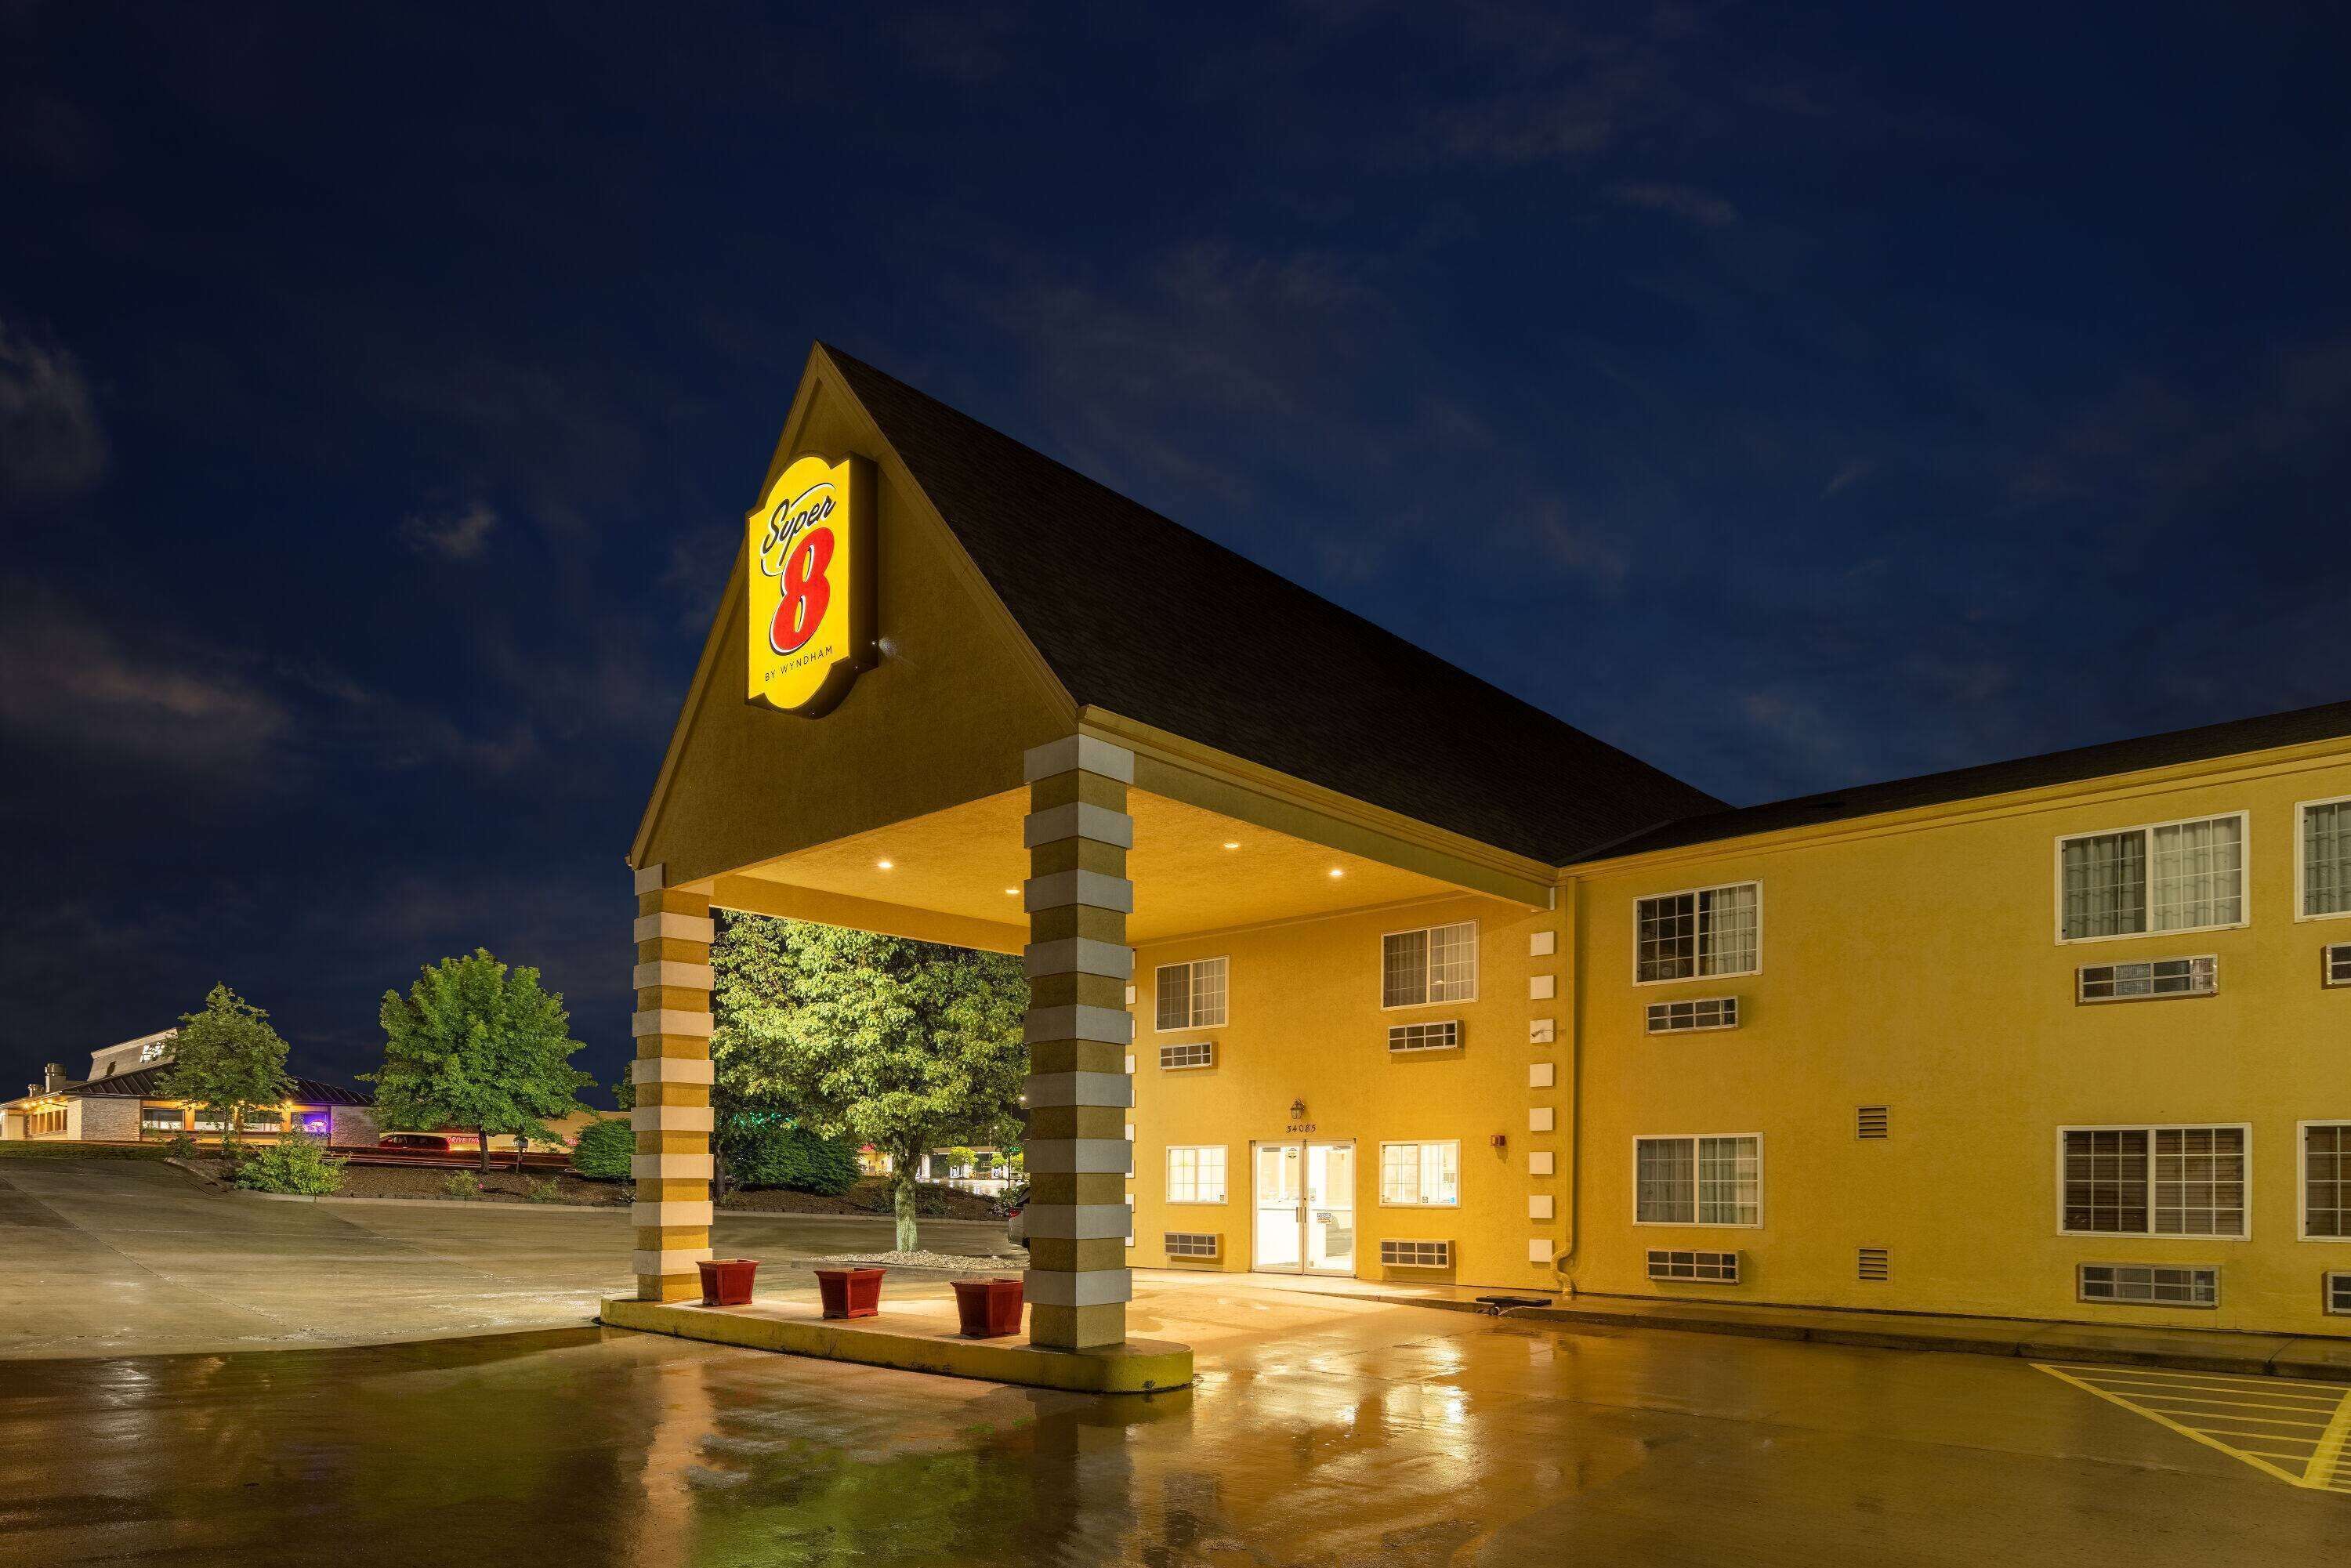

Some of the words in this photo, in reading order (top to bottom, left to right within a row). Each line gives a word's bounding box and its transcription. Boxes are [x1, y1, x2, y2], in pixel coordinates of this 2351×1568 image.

[761, 483, 837, 577] Super
[769, 527, 835, 656] 8
[765, 669, 776, 682] BY
[780, 646, 832, 675] WYNDHAM
[1285, 1124, 1317, 1133] 34085
